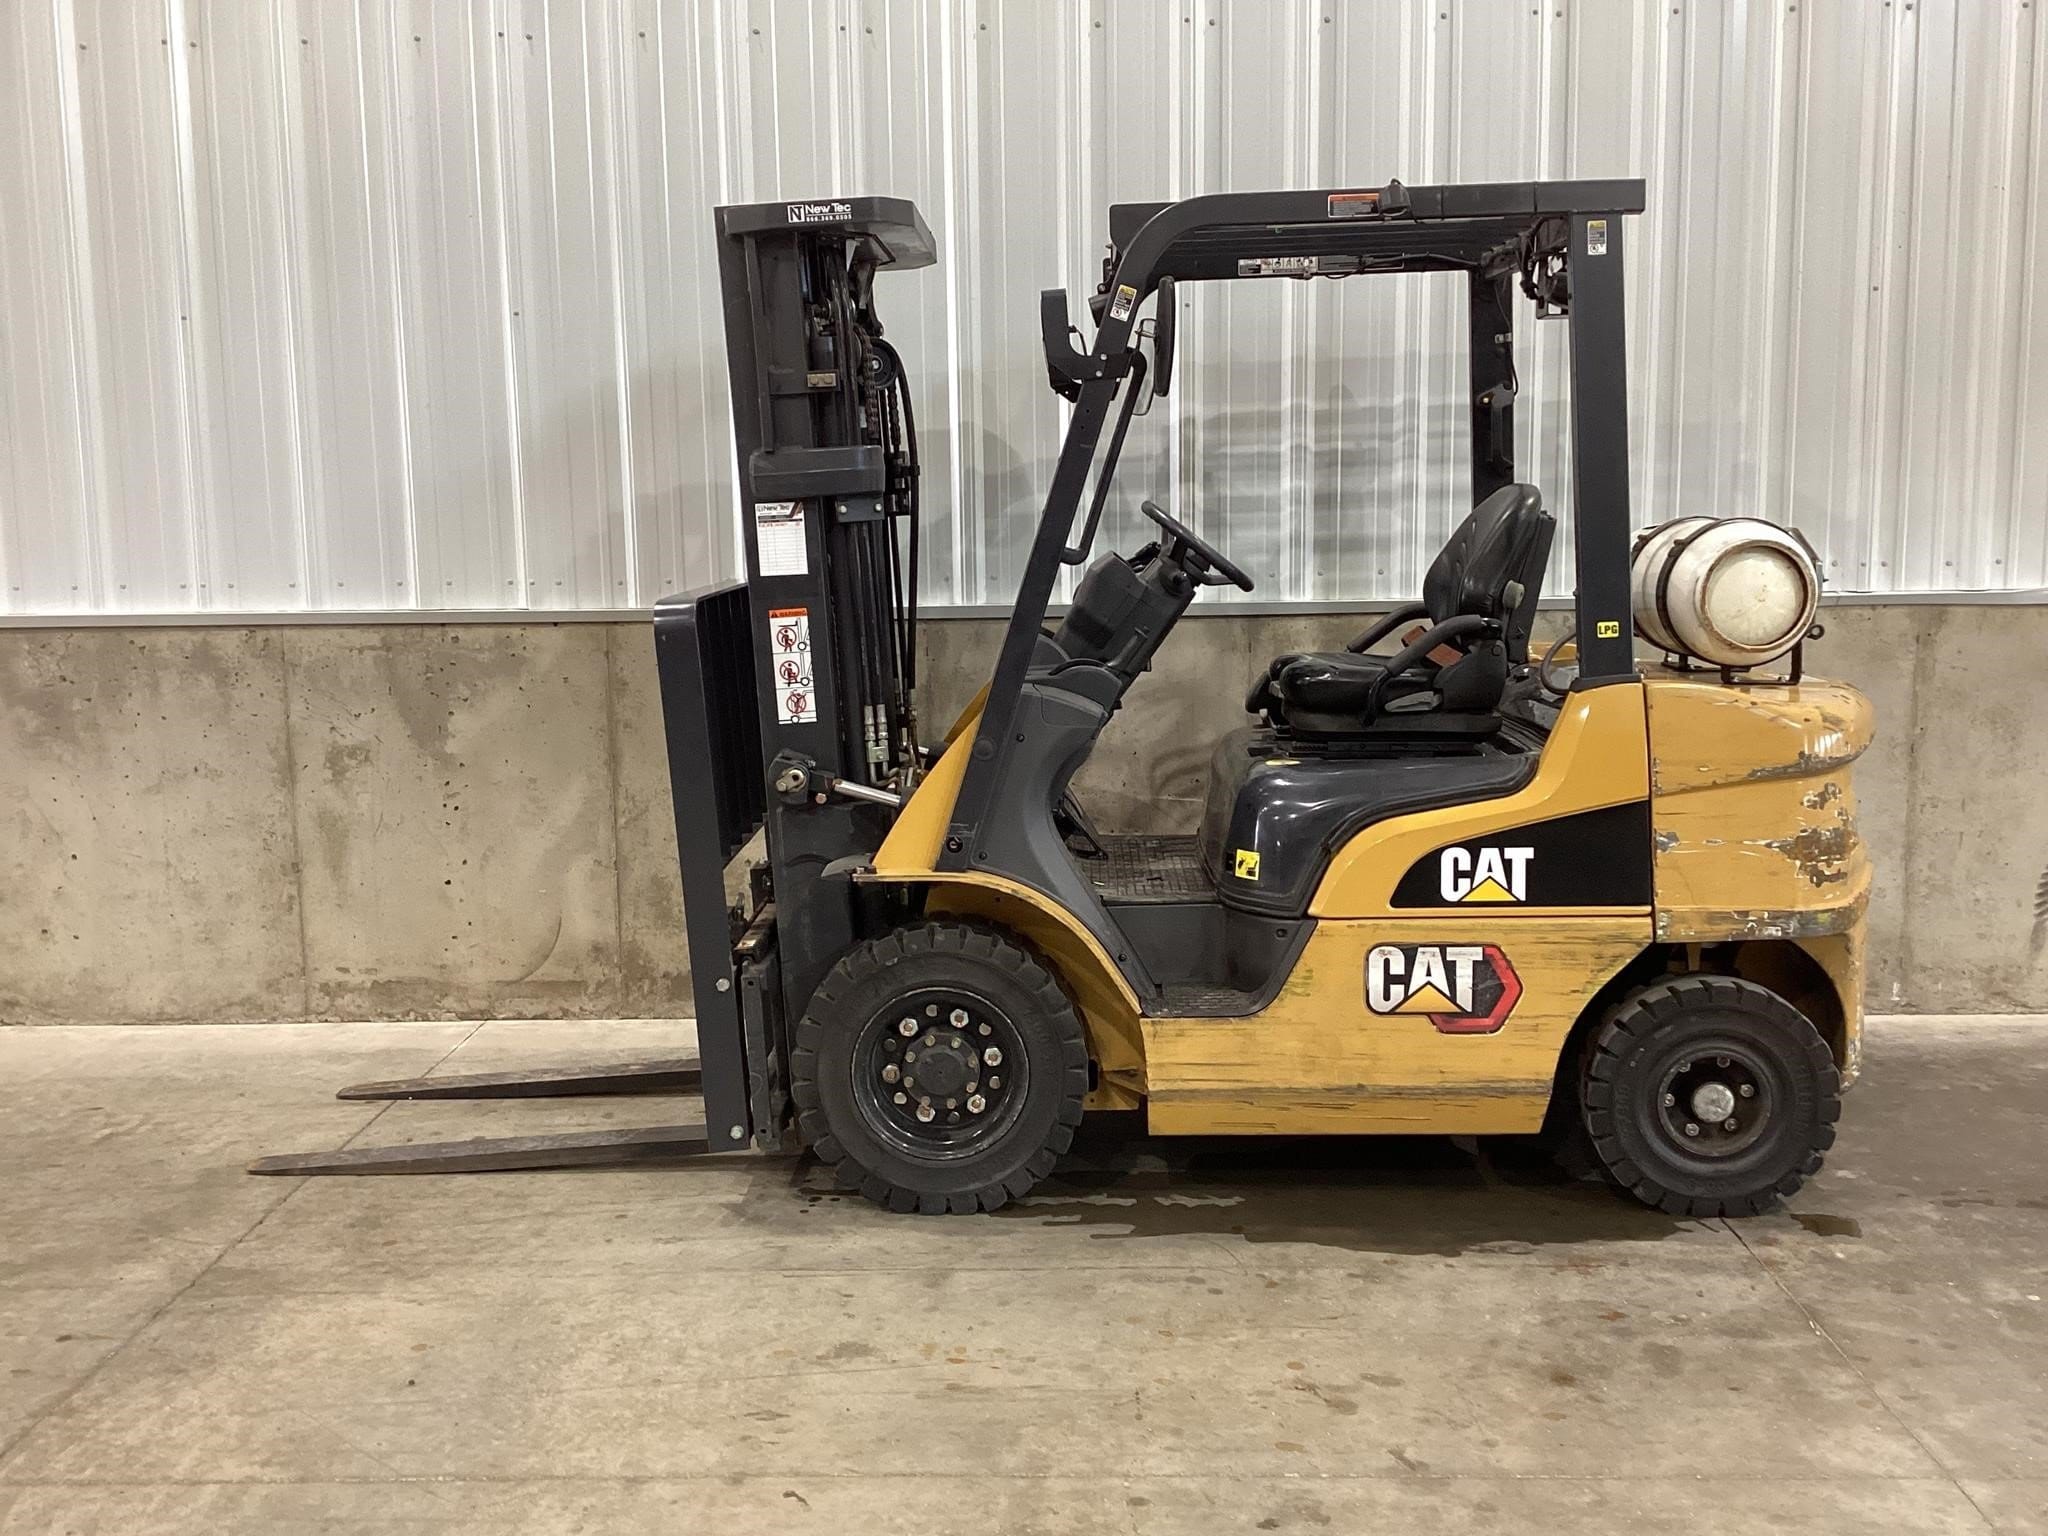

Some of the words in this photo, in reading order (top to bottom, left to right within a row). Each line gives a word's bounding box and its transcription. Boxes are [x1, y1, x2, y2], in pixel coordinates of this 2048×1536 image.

[805, 204, 830, 214] New
[831, 203, 852, 212] Tec
[1599, 624, 1618, 635] LPG
[1440, 847, 1534, 901] CAT
[1368, 946, 1483, 1012] CAT
